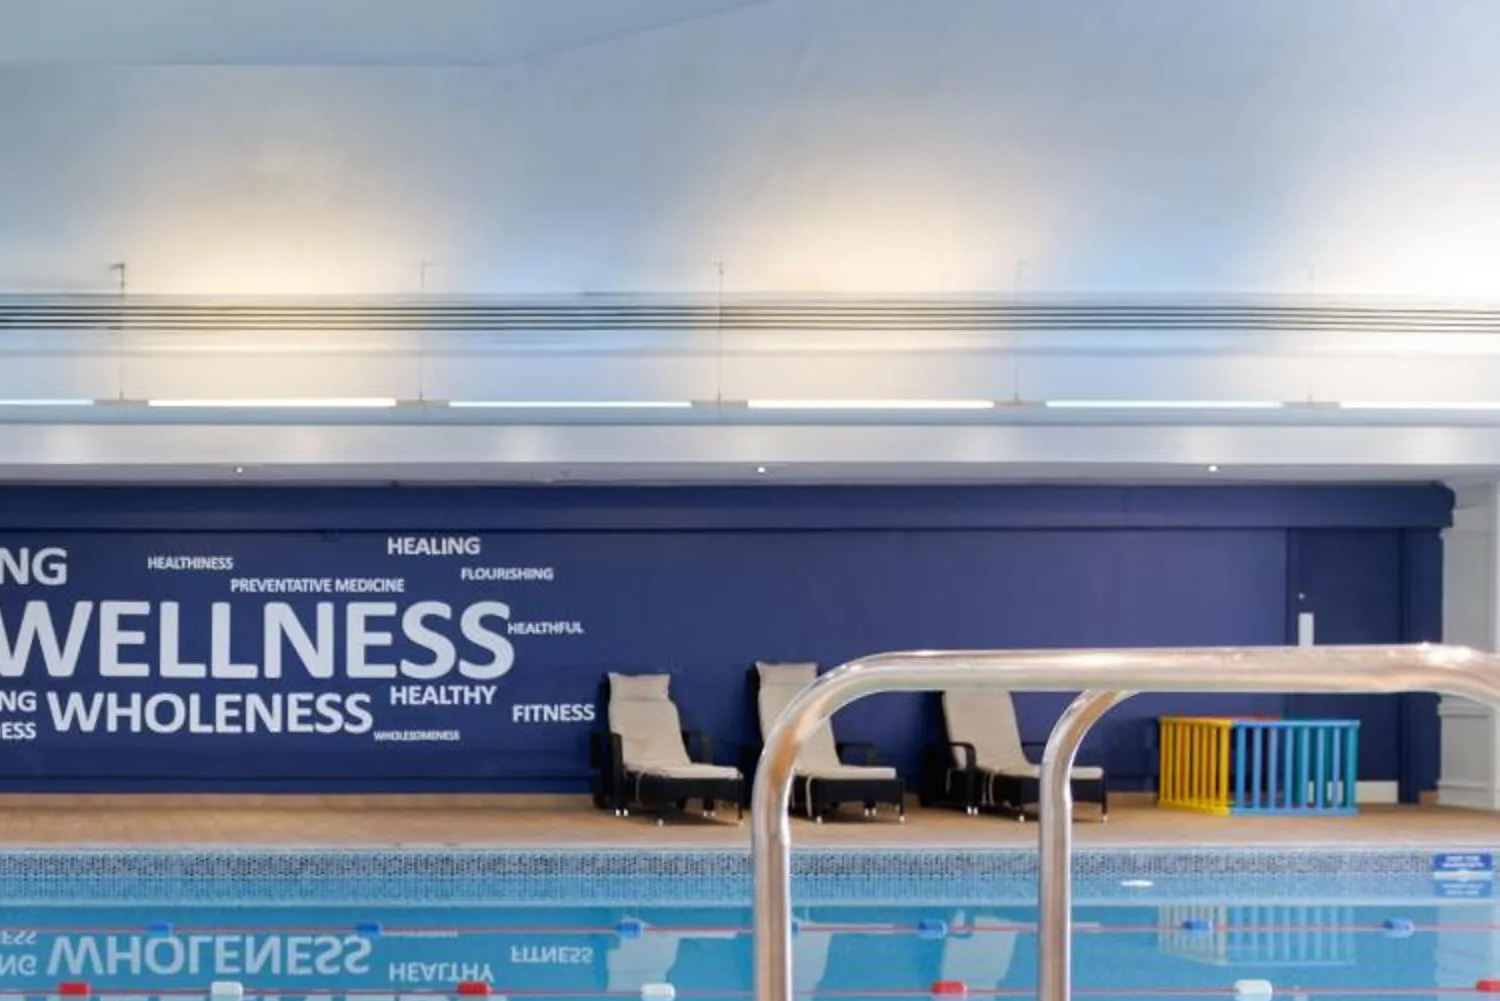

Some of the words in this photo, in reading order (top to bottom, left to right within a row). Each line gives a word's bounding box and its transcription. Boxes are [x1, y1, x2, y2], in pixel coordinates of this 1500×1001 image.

[386, 536, 482, 556] HEALING
[147, 556, 235, 571] HEALTHINESS
[459, 566, 555, 582] FLOURISHING
[229, 577, 333, 593] PREVENTATIVE
[334, 577, 406, 593] MEDICINE
[506, 620, 585, 636] HEALTHFUL
[389, 684, 498, 706] HEALTHY
[45, 690, 374, 735] WHOLENESS
[511, 702, 596, 723] FITNESS
